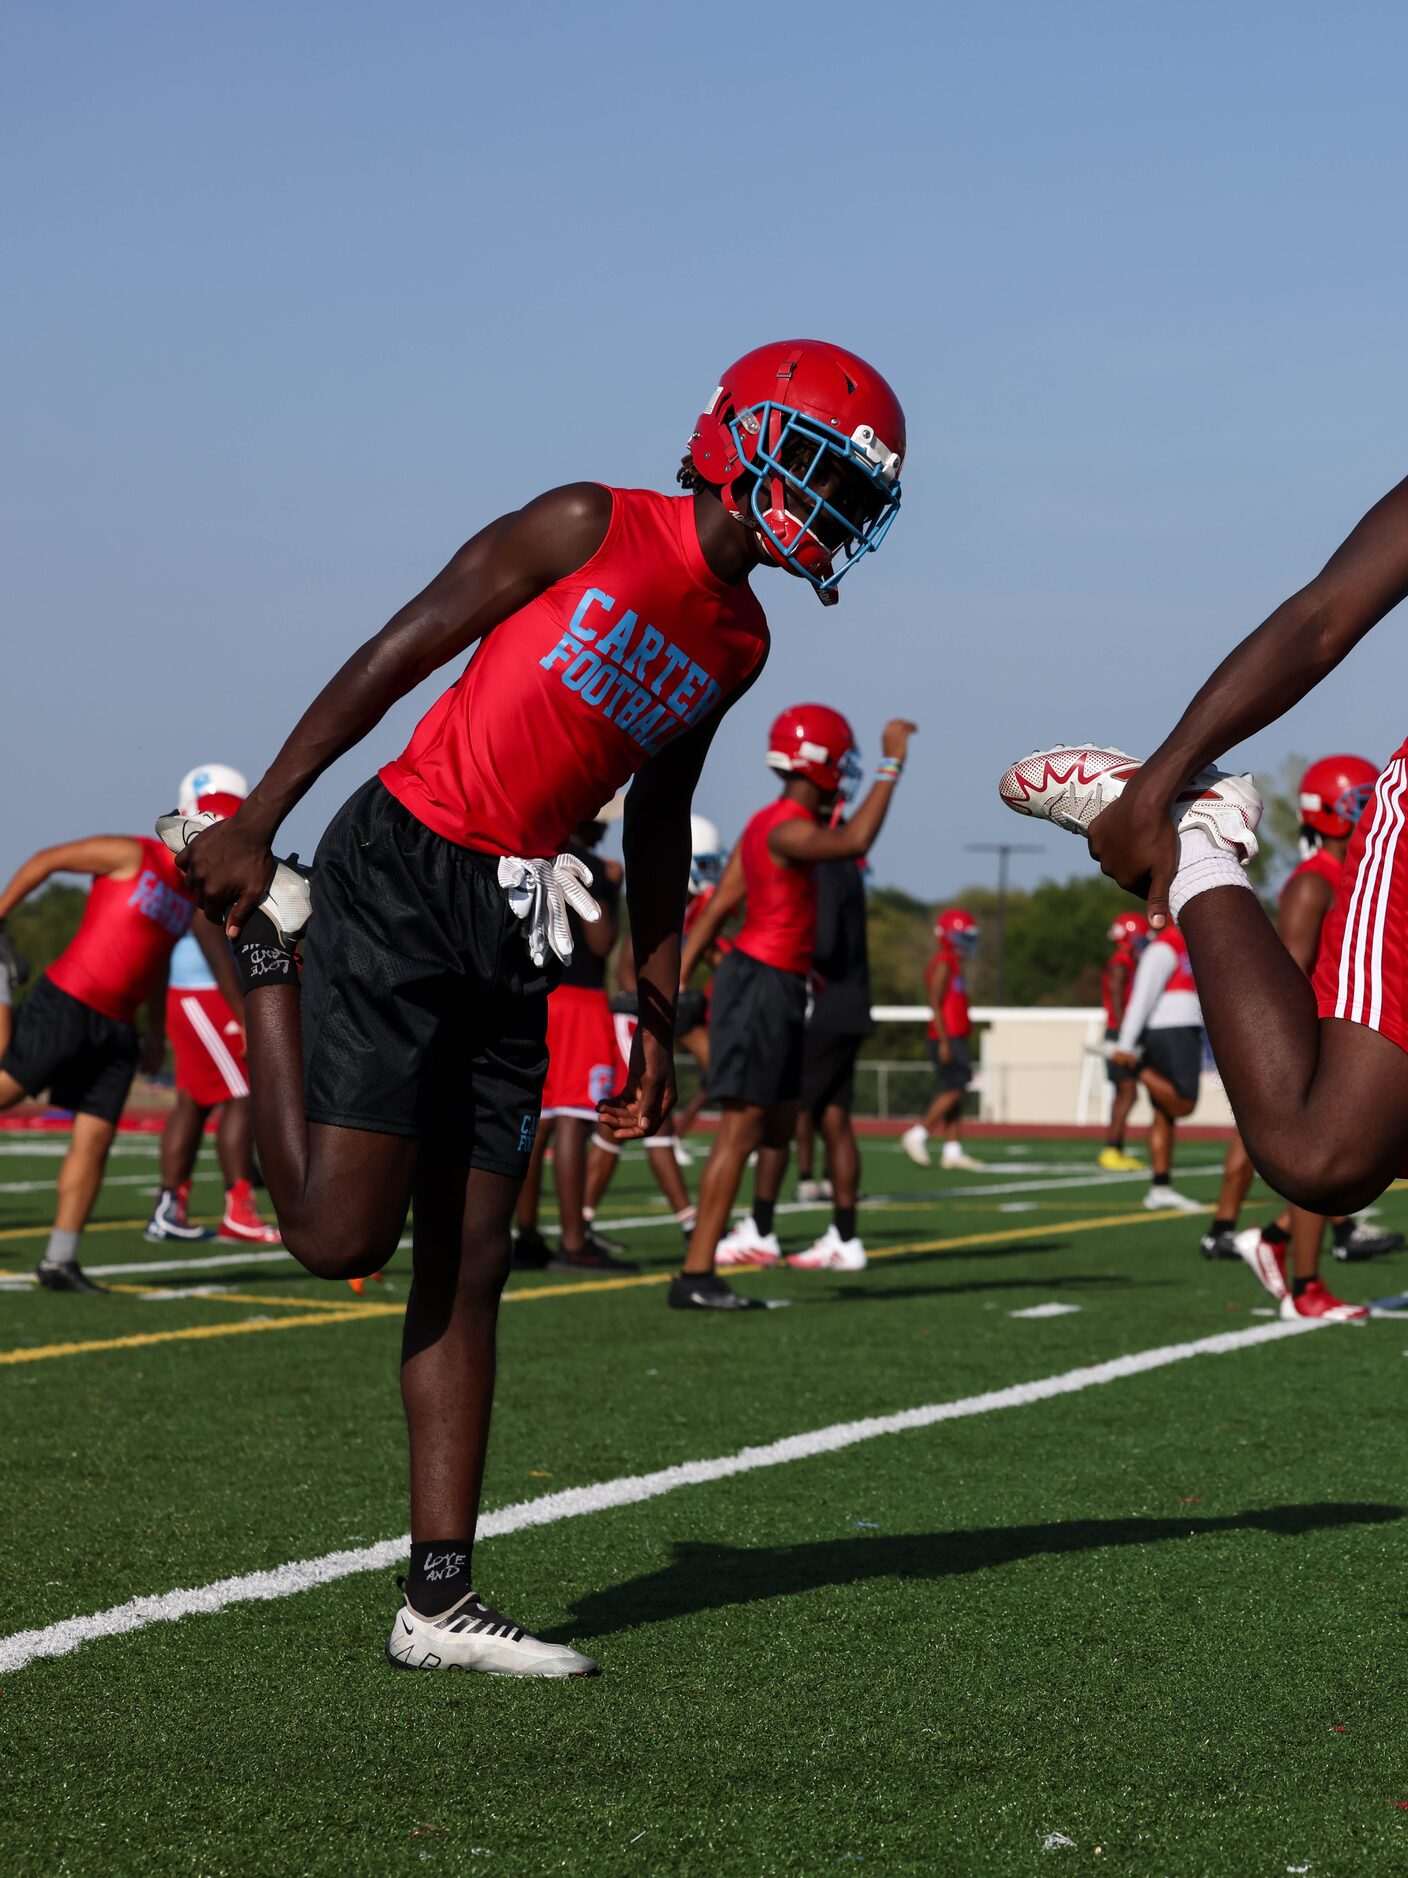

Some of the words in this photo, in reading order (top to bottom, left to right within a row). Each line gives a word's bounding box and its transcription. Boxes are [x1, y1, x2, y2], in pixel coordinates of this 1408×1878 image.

[569, 587, 722, 728] CARTER
[539, 631, 686, 758] FOOTBAL
[423, 1552, 466, 1571] LOVE
[426, 1564, 460, 1582] AND
